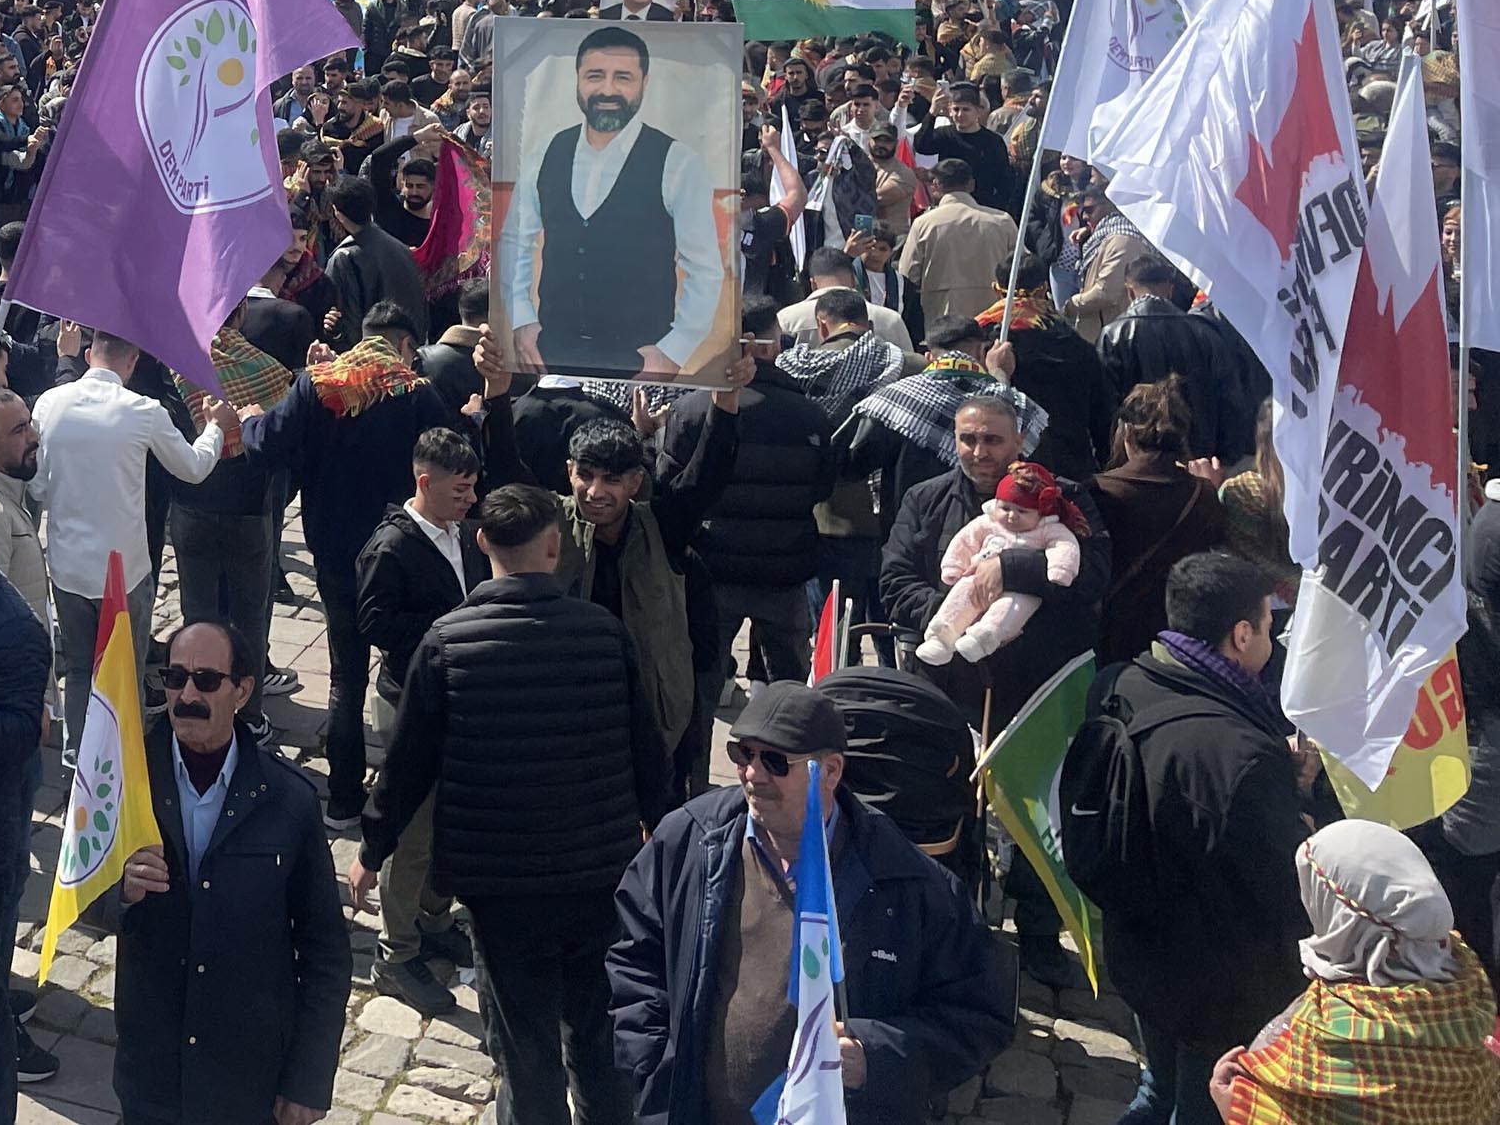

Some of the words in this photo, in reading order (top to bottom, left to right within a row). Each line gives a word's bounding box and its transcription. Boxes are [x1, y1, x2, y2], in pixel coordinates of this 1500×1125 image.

[159, 139, 180, 186] DEM
[175, 174, 209, 202] PARTİ
[1318, 495, 1423, 659] ARTİ
